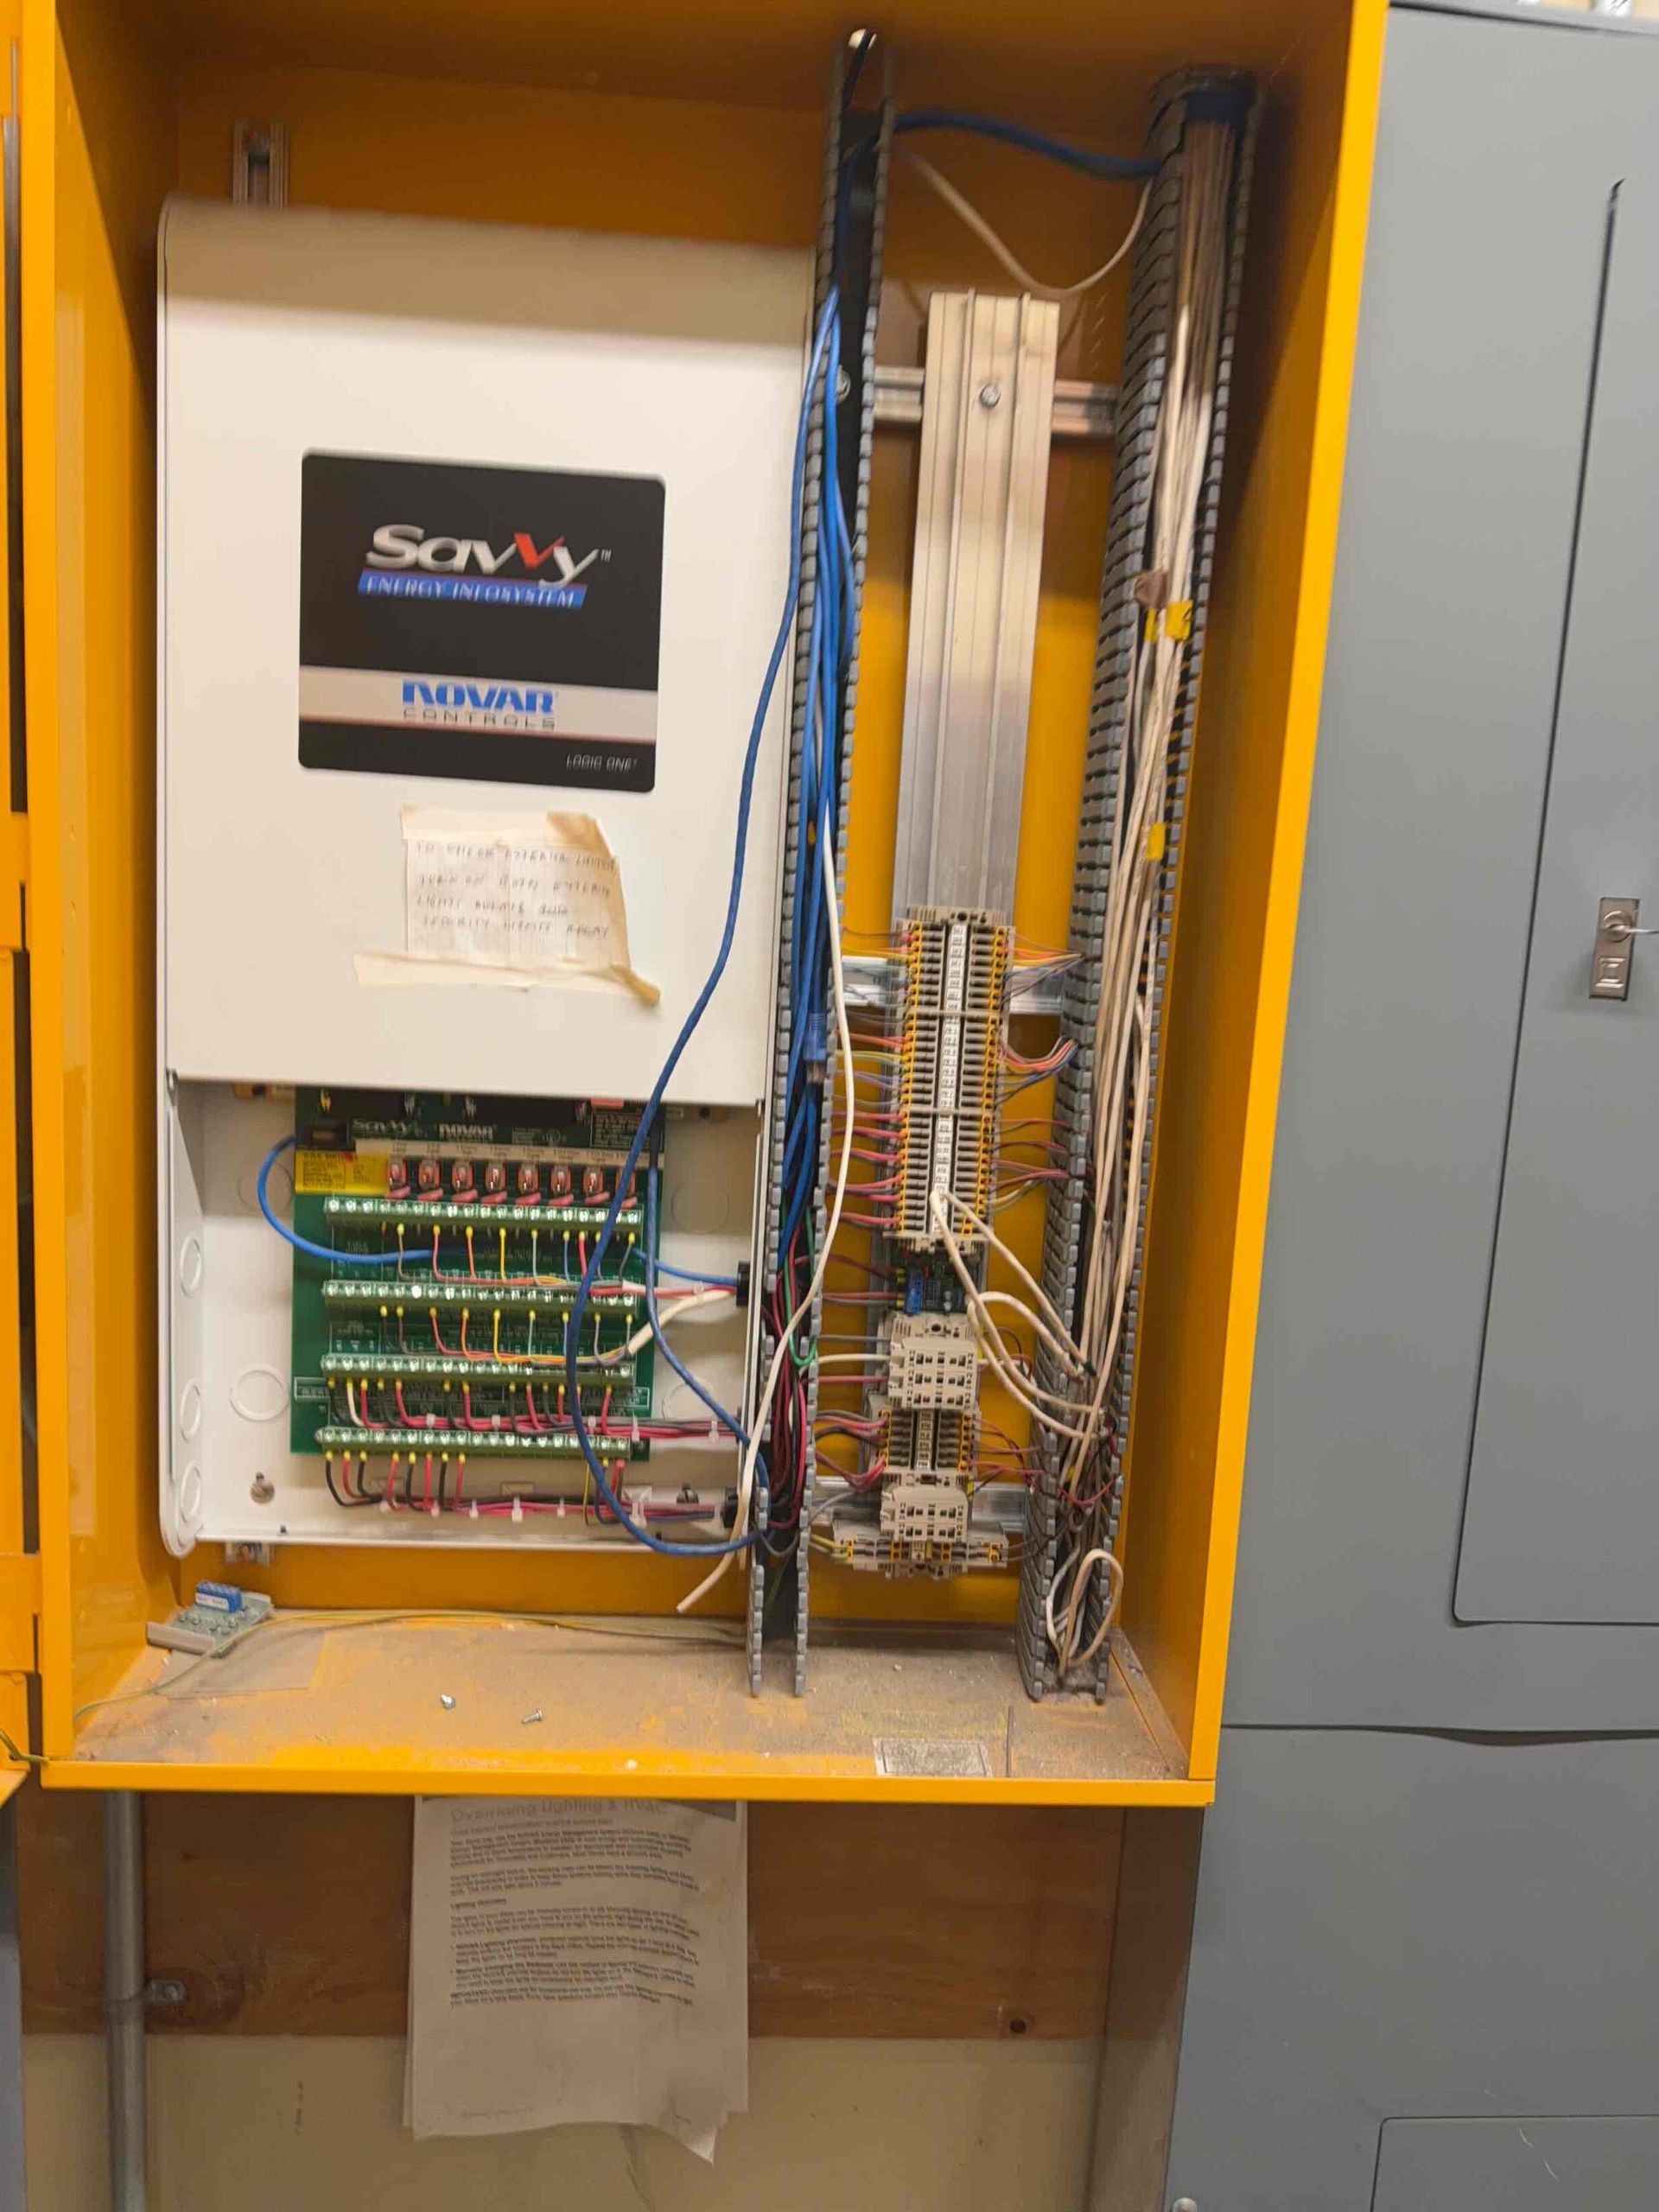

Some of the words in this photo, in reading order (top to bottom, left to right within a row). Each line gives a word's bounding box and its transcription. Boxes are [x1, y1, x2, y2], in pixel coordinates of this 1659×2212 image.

[365, 524, 599, 592] Savvy
[366, 575, 443, 599] ENERGY
[402, 679, 553, 714] NOVAR
[403, 707, 555, 729] CONTROLS
